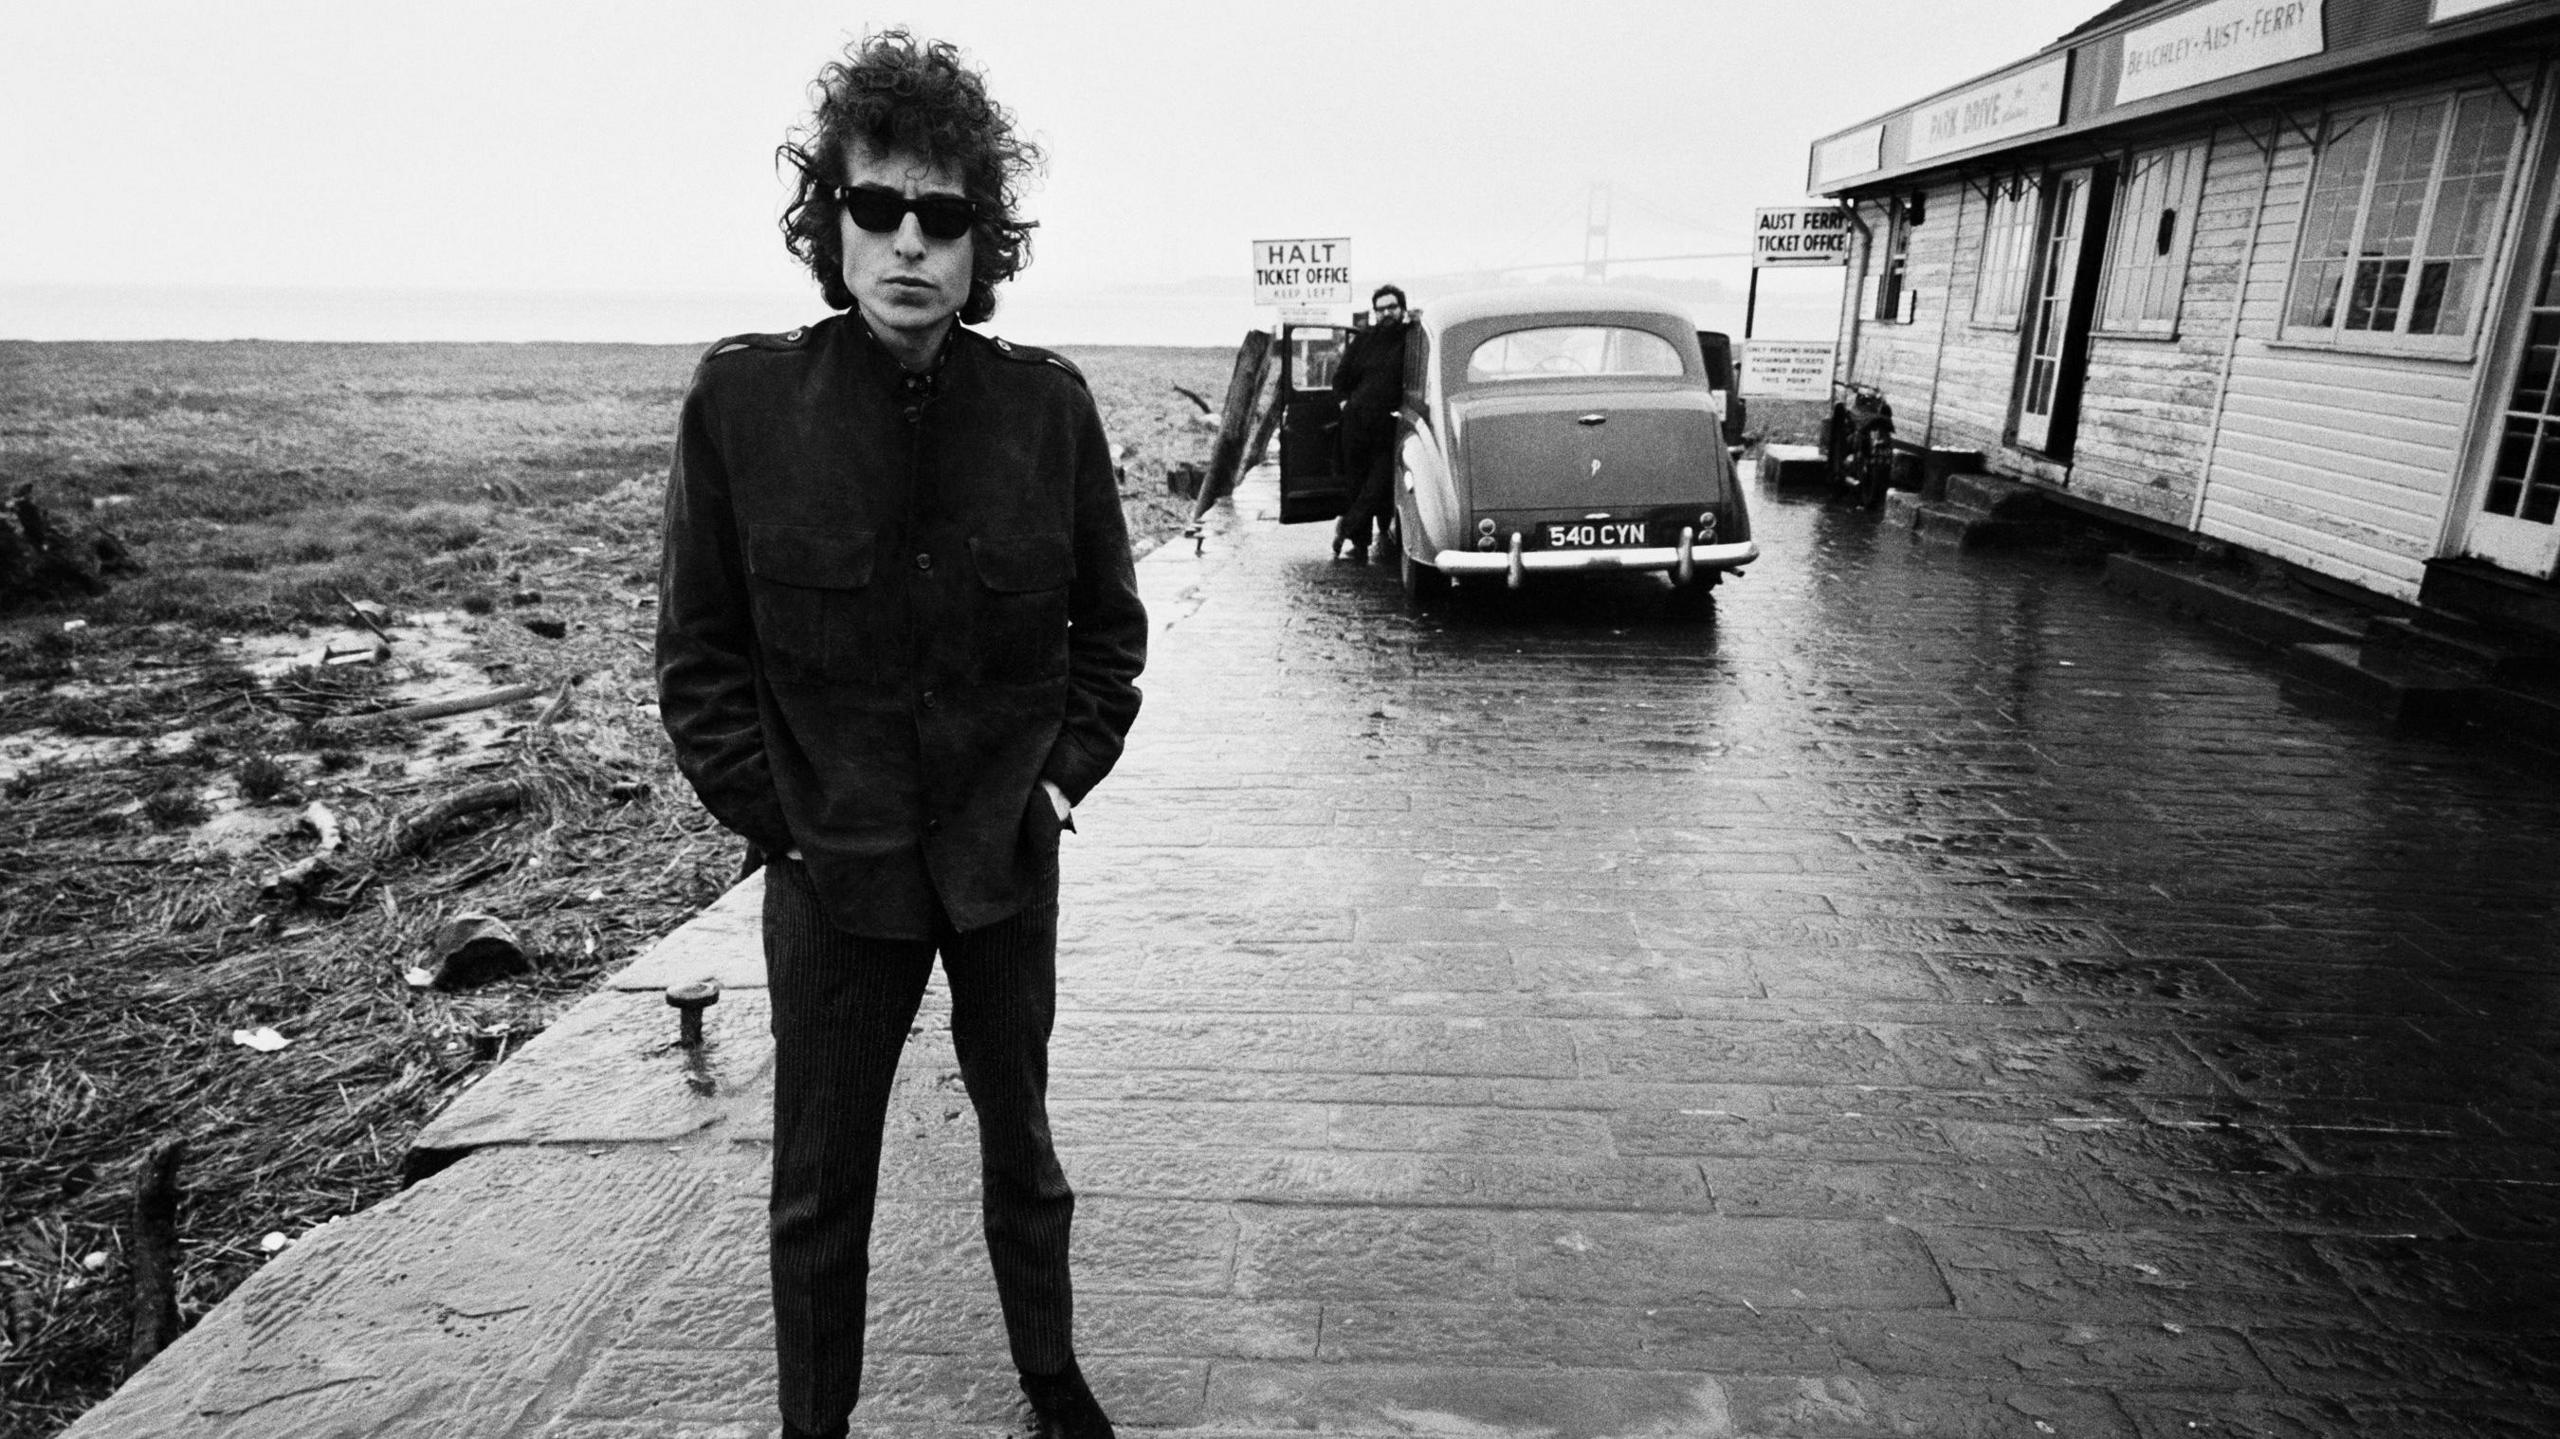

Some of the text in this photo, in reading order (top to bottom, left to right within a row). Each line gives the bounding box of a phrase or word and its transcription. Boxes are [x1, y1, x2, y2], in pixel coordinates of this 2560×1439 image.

[1962, 92, 2002, 134] DRIVE
[1759, 212, 1844, 230] AUST FERRY
[1758, 233, 1845, 252] TICKET OFFICE
[1268, 244, 1335, 264] HALT
[1256, 267, 1348, 285] TICKET OFFICE
[1549, 524, 1645, 546] 540 CYN
